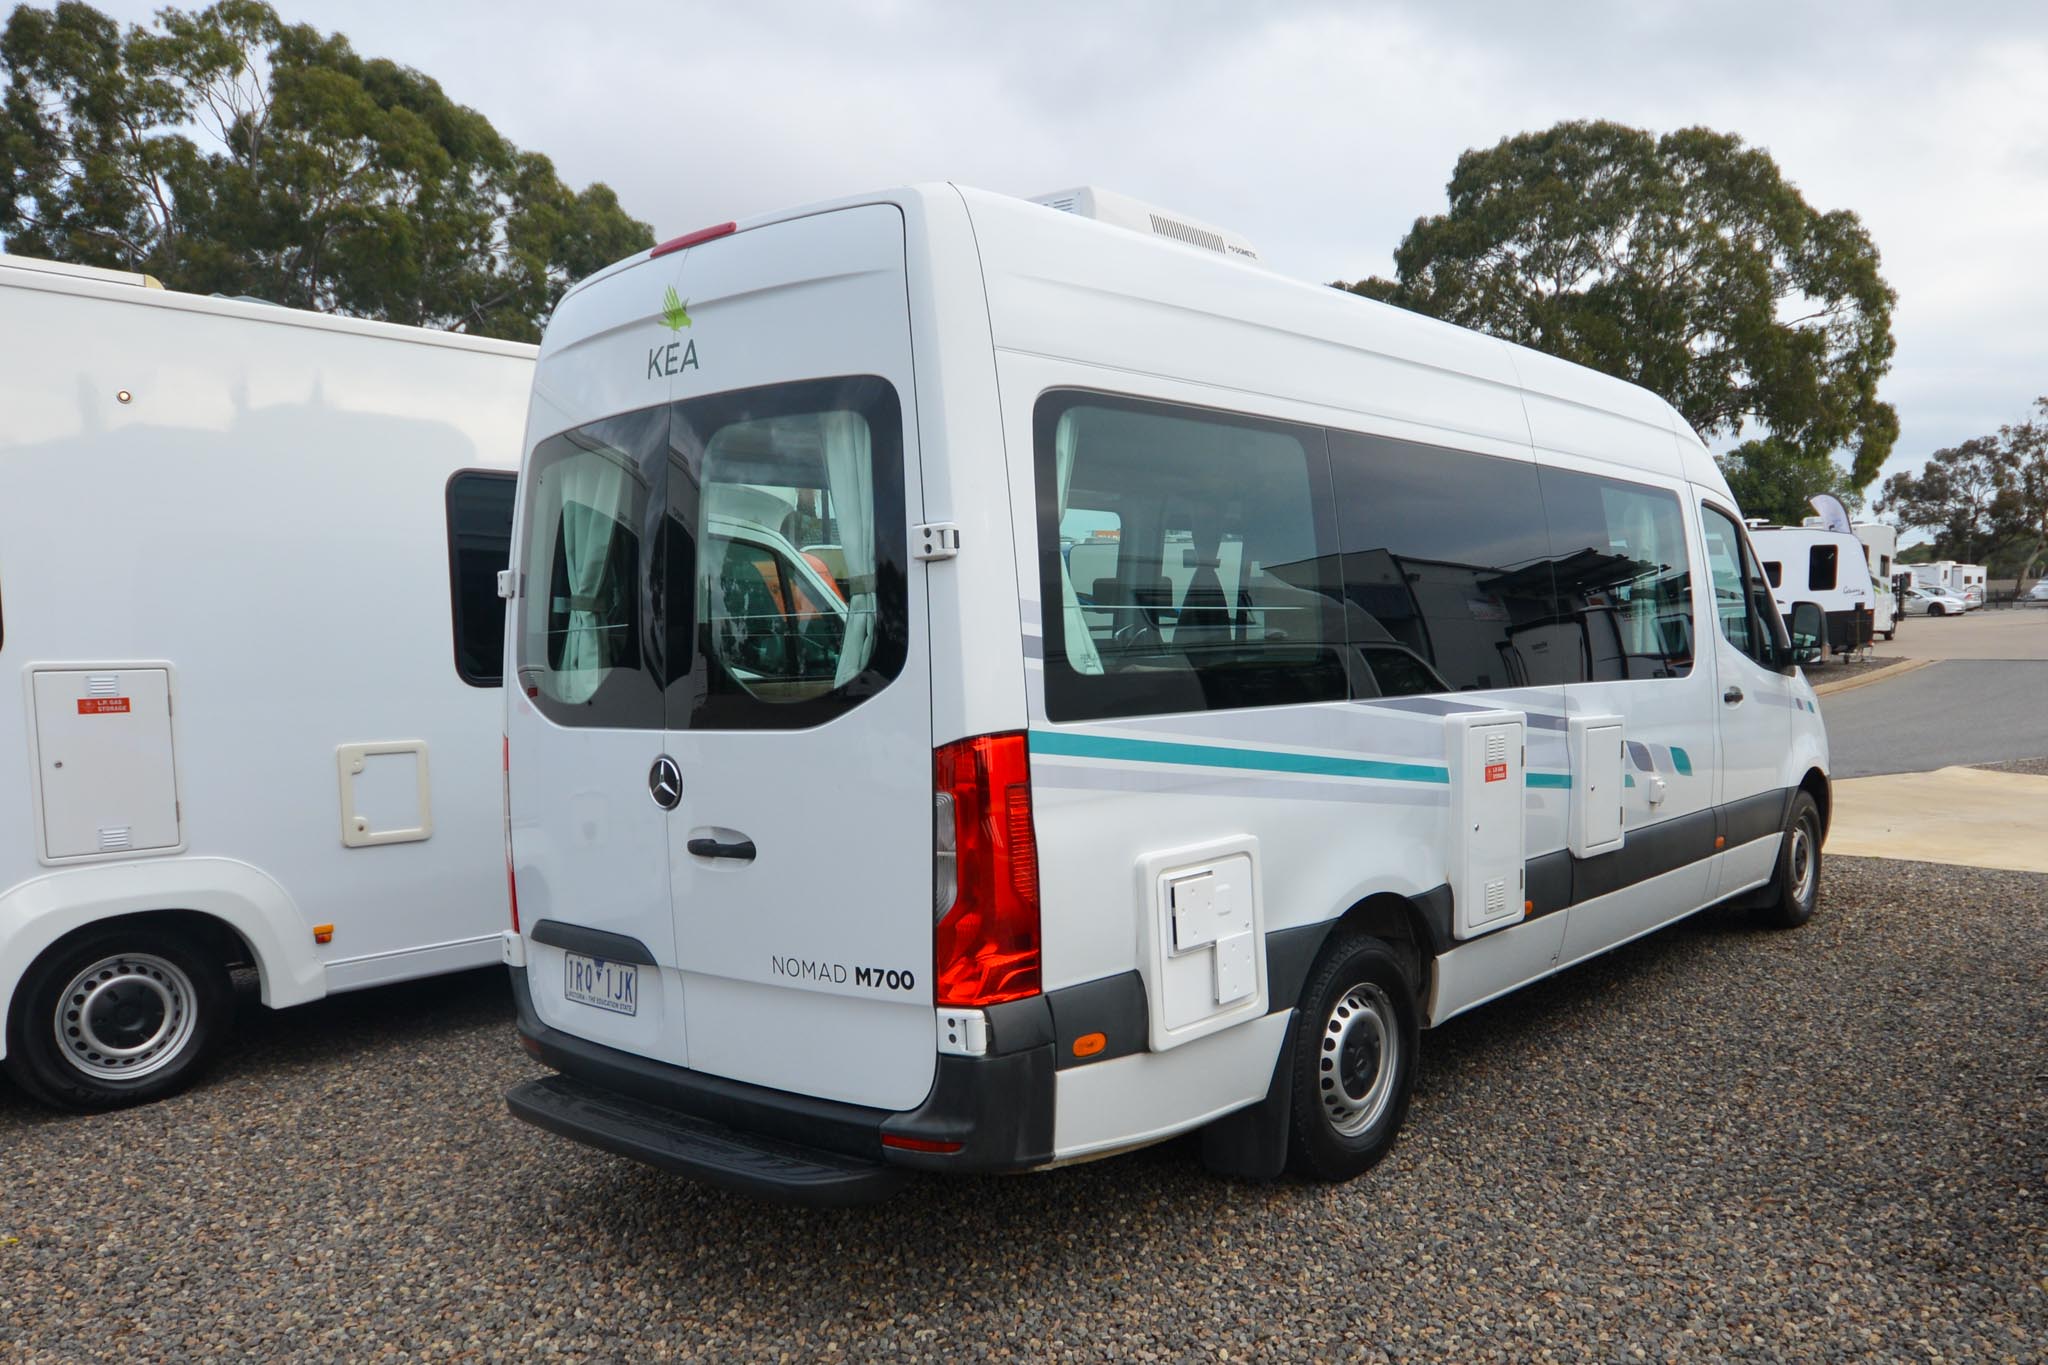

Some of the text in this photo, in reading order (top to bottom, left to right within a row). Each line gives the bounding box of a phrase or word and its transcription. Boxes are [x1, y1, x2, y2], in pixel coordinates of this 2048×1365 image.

[647, 338, 699, 380] KEA
[606, 968, 633, 1004] 1JK
[772, 955, 915, 991] NOMAD M700
